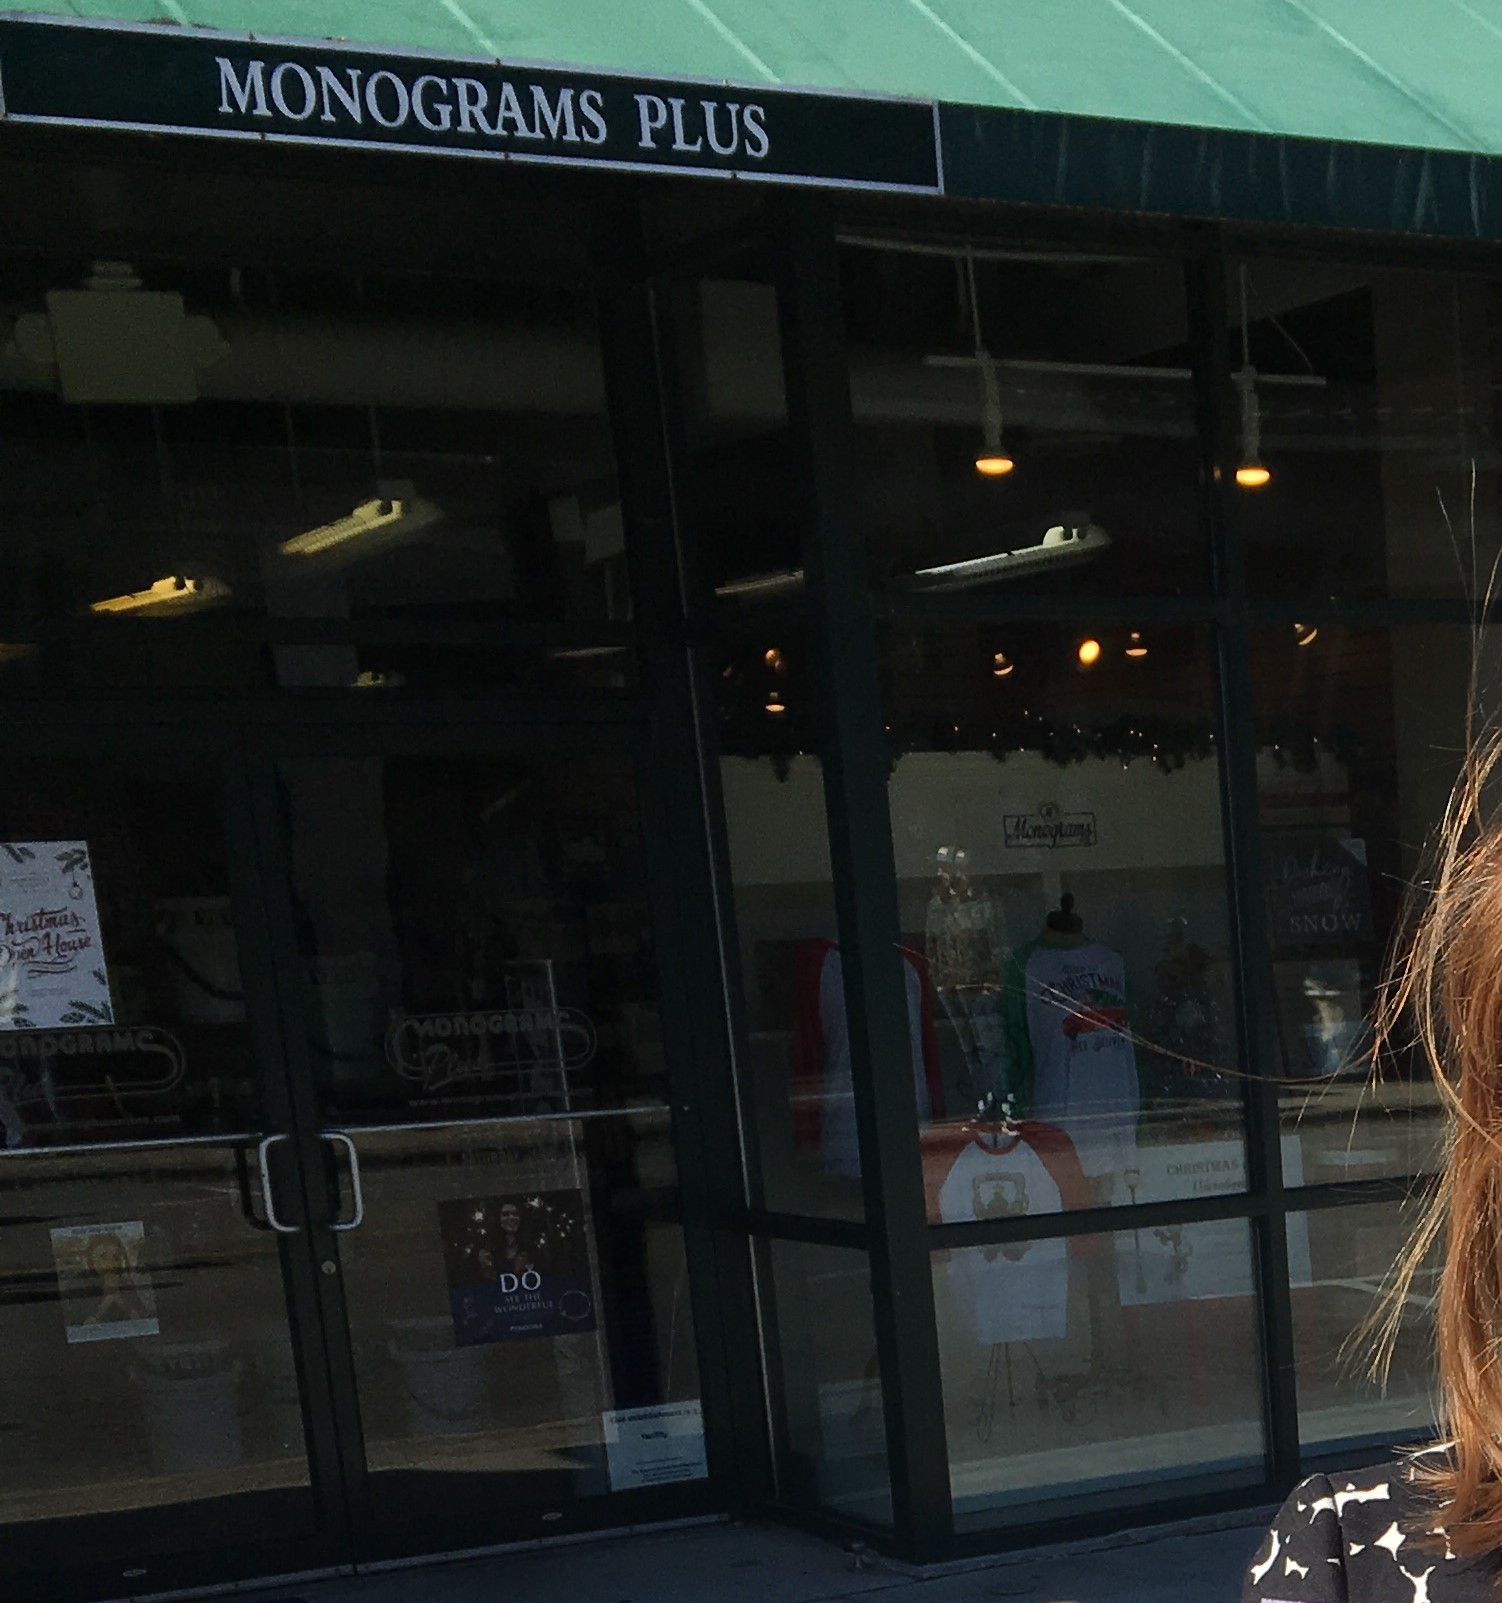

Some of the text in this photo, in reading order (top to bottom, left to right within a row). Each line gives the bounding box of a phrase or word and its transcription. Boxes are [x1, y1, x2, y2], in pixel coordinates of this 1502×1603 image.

[214, 56, 771, 160] MONOGRAMS PLUS
[0, 907, 86, 936] hristmas
